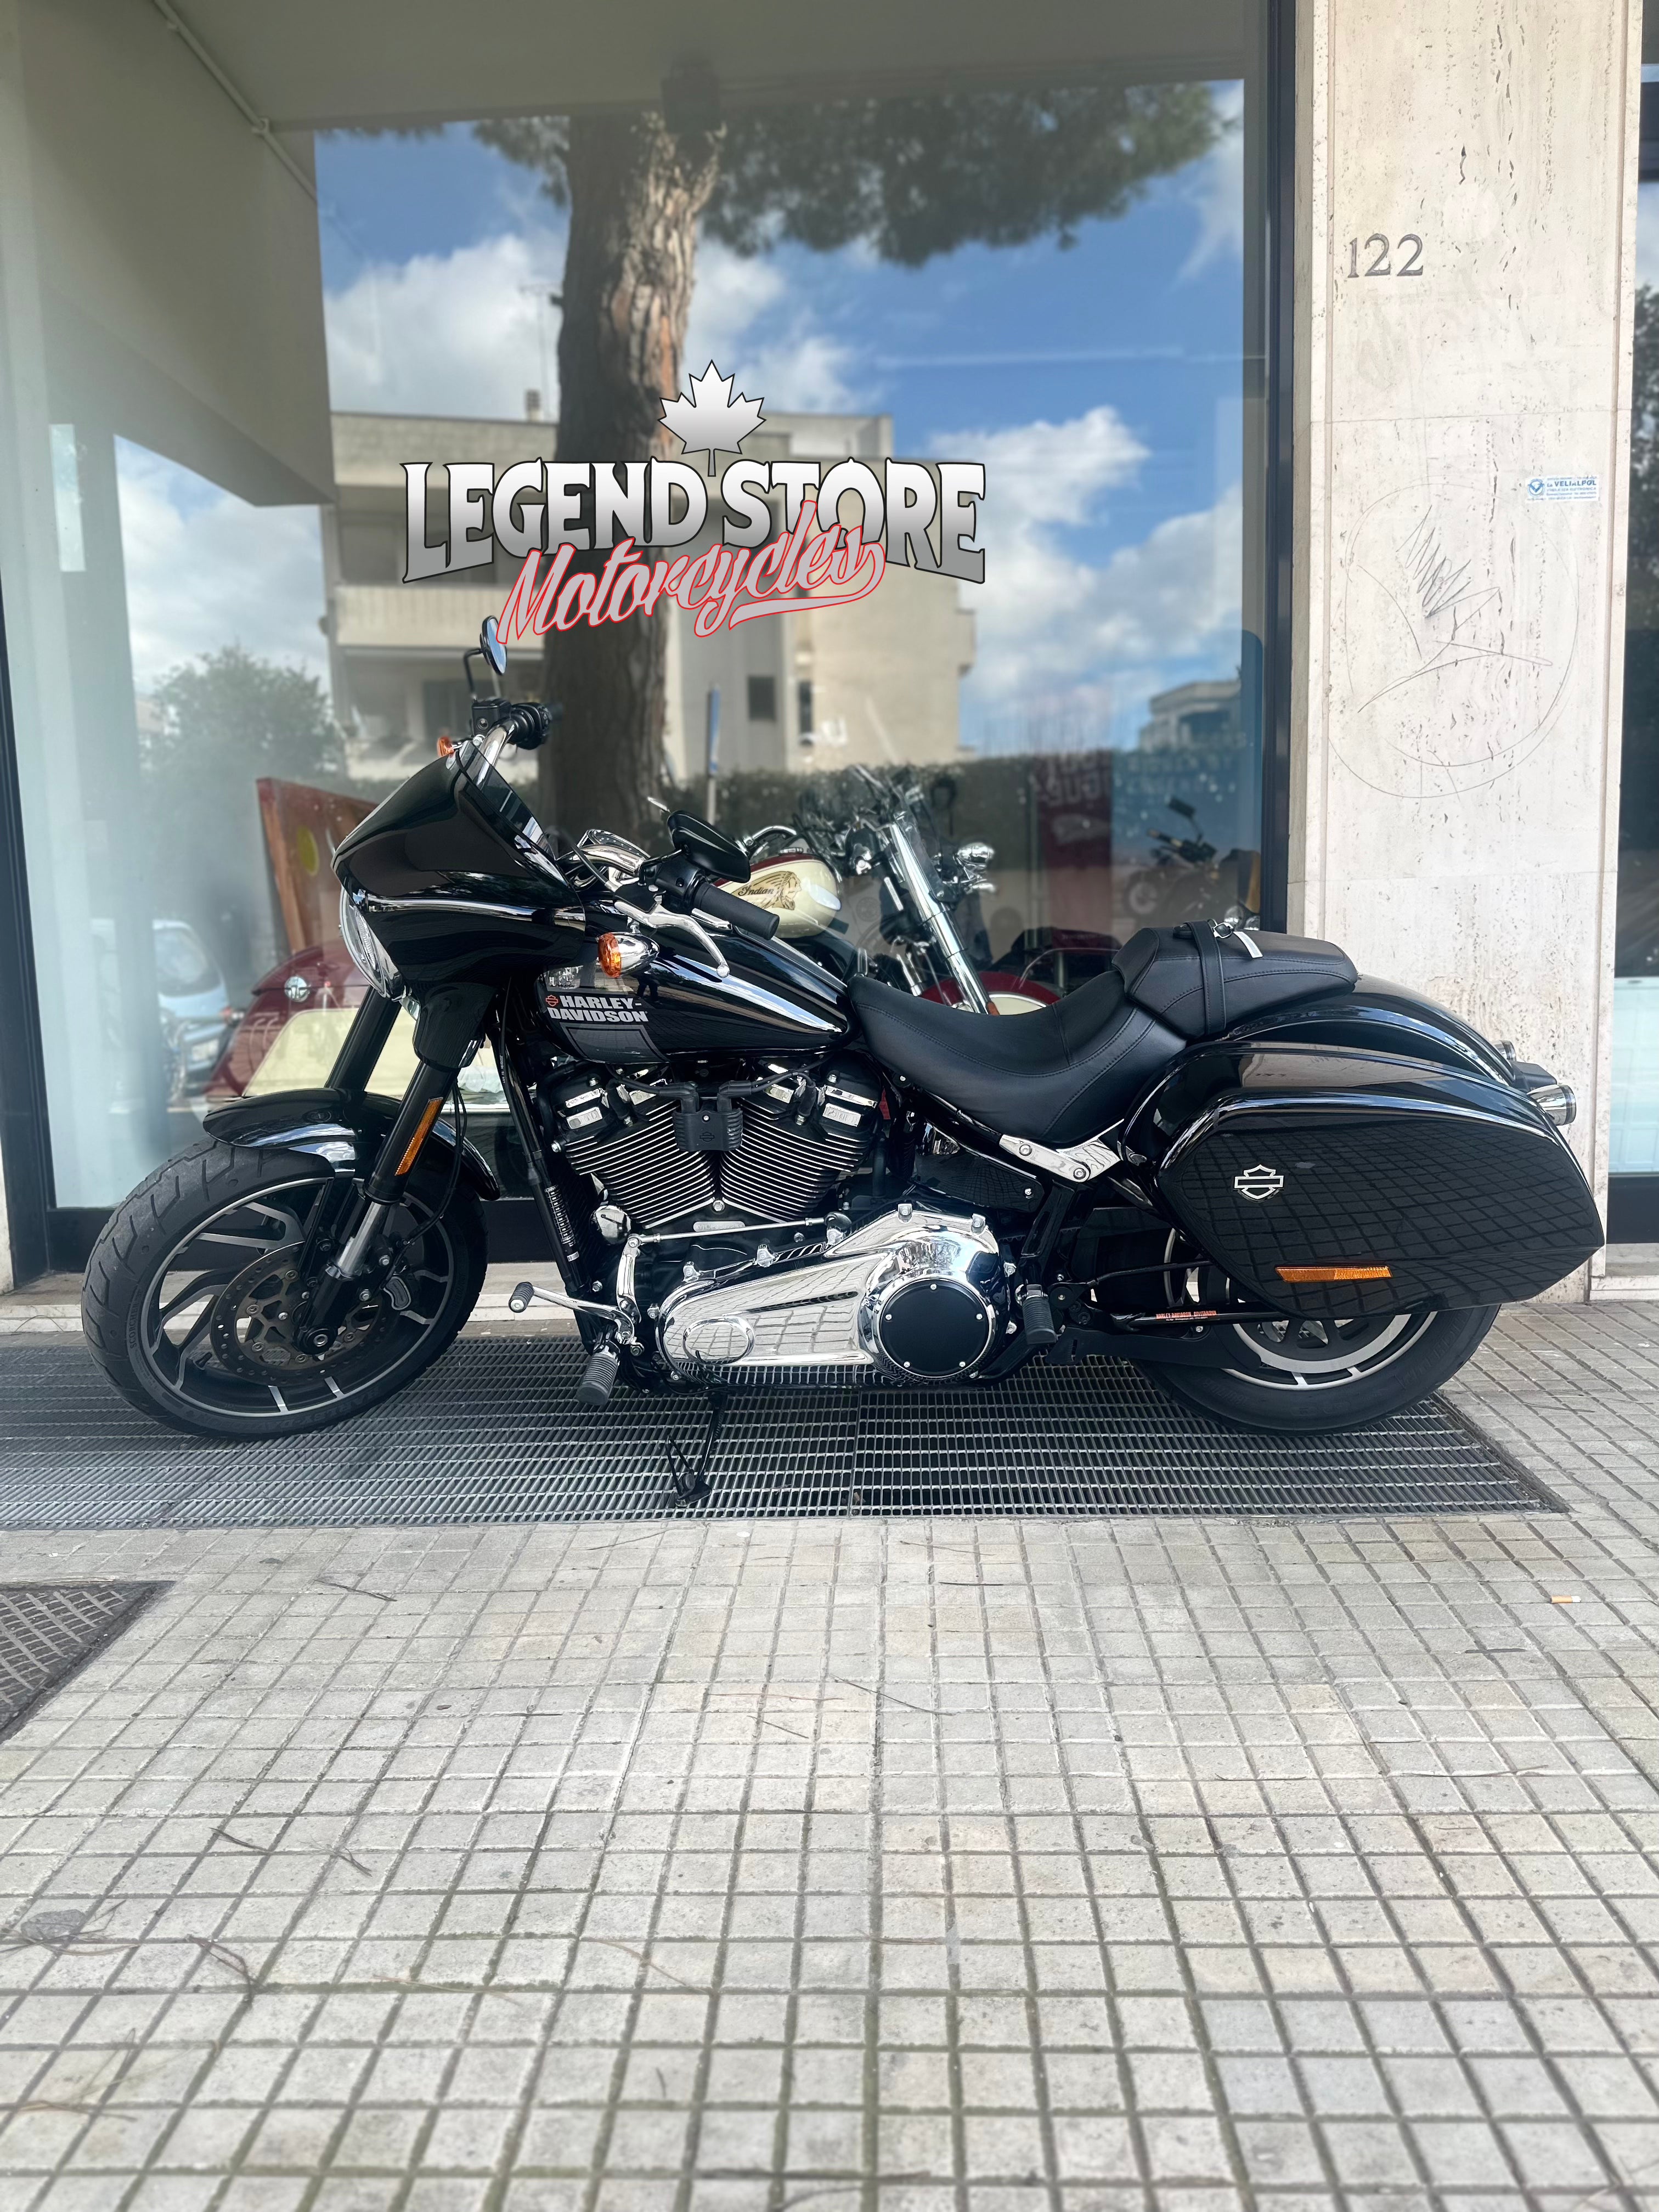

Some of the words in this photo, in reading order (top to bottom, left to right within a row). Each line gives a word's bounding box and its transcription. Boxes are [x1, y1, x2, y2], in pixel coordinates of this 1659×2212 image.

[1347, 233, 1424, 278] 122
[738, 885, 774, 896] Indian
[559, 995, 642, 1009] HARLEY-
[547, 1007, 649, 1022] DAVIDSON
[128, 1302, 139, 1349] SCORCHER
